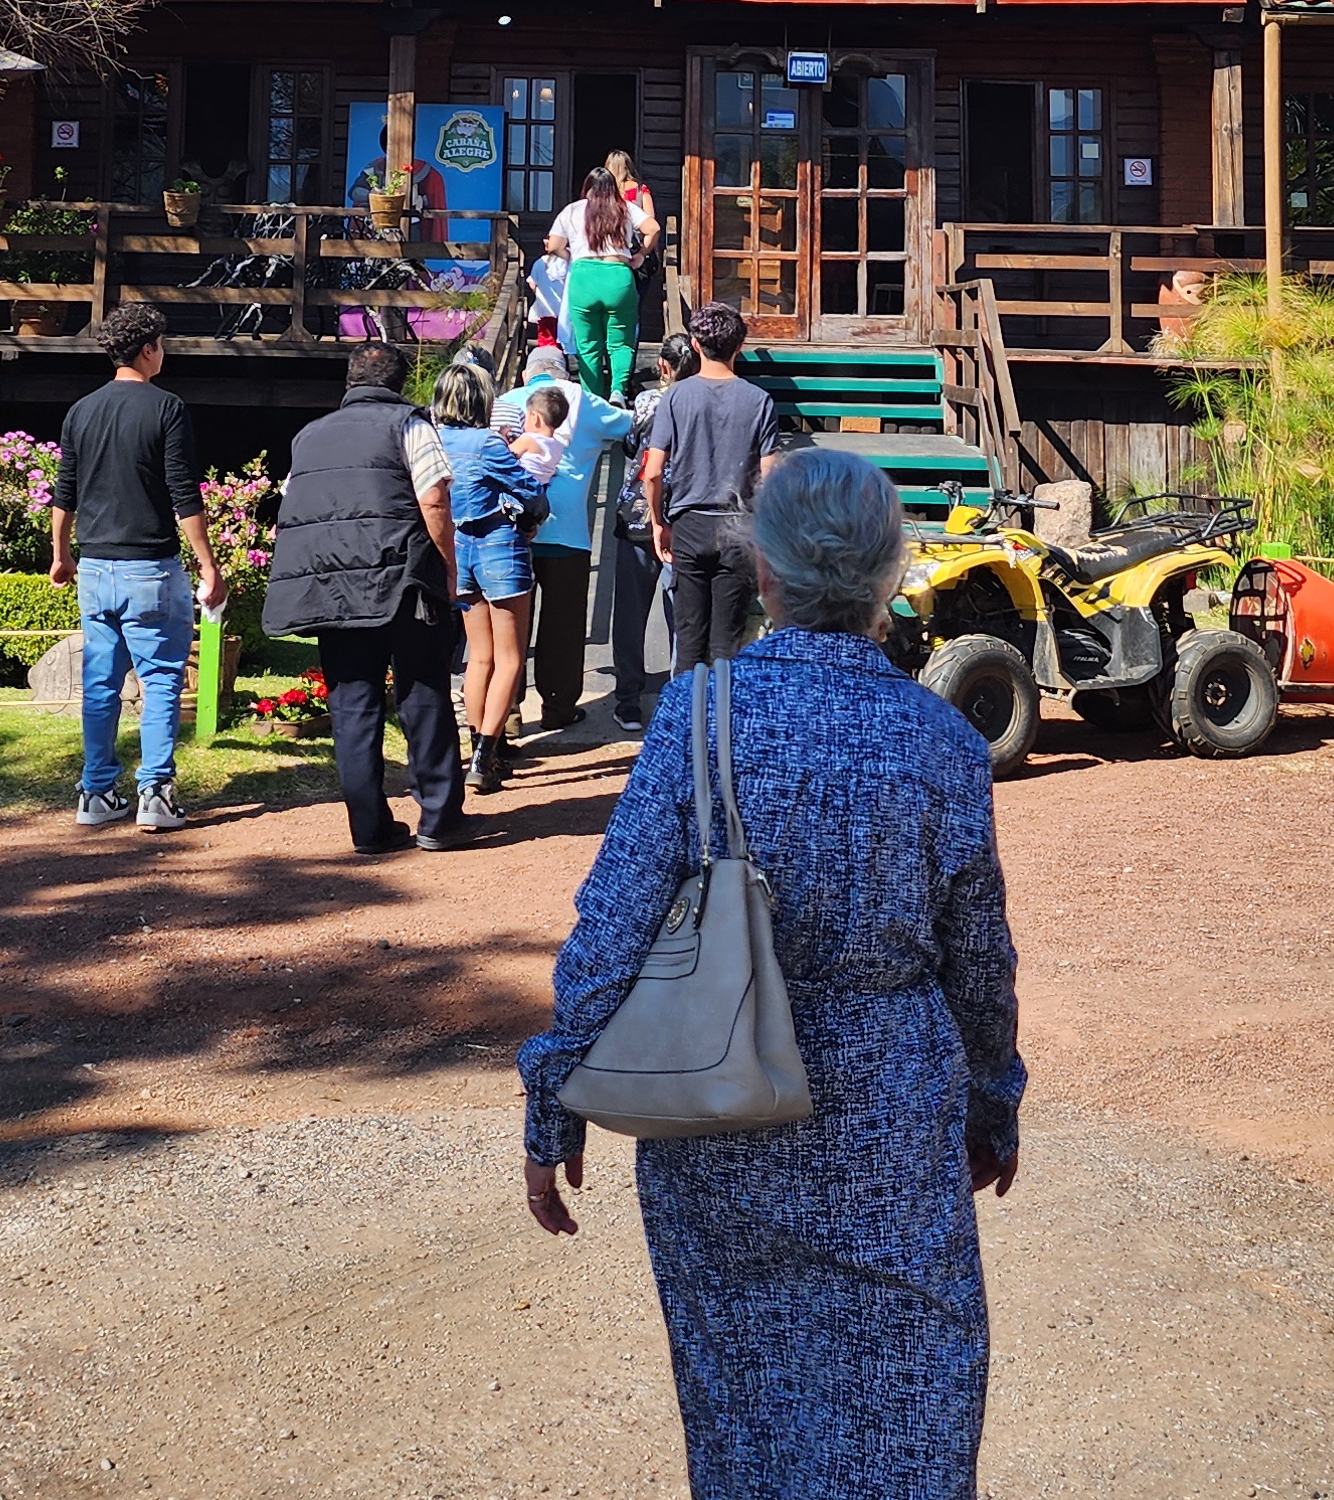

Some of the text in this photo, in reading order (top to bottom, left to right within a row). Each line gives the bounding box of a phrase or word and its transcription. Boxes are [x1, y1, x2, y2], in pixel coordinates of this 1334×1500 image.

[790, 60, 824, 77] ABIERTO
[445, 137, 488, 149] CABAÑA
[443, 147, 490, 159] ALEGRE
